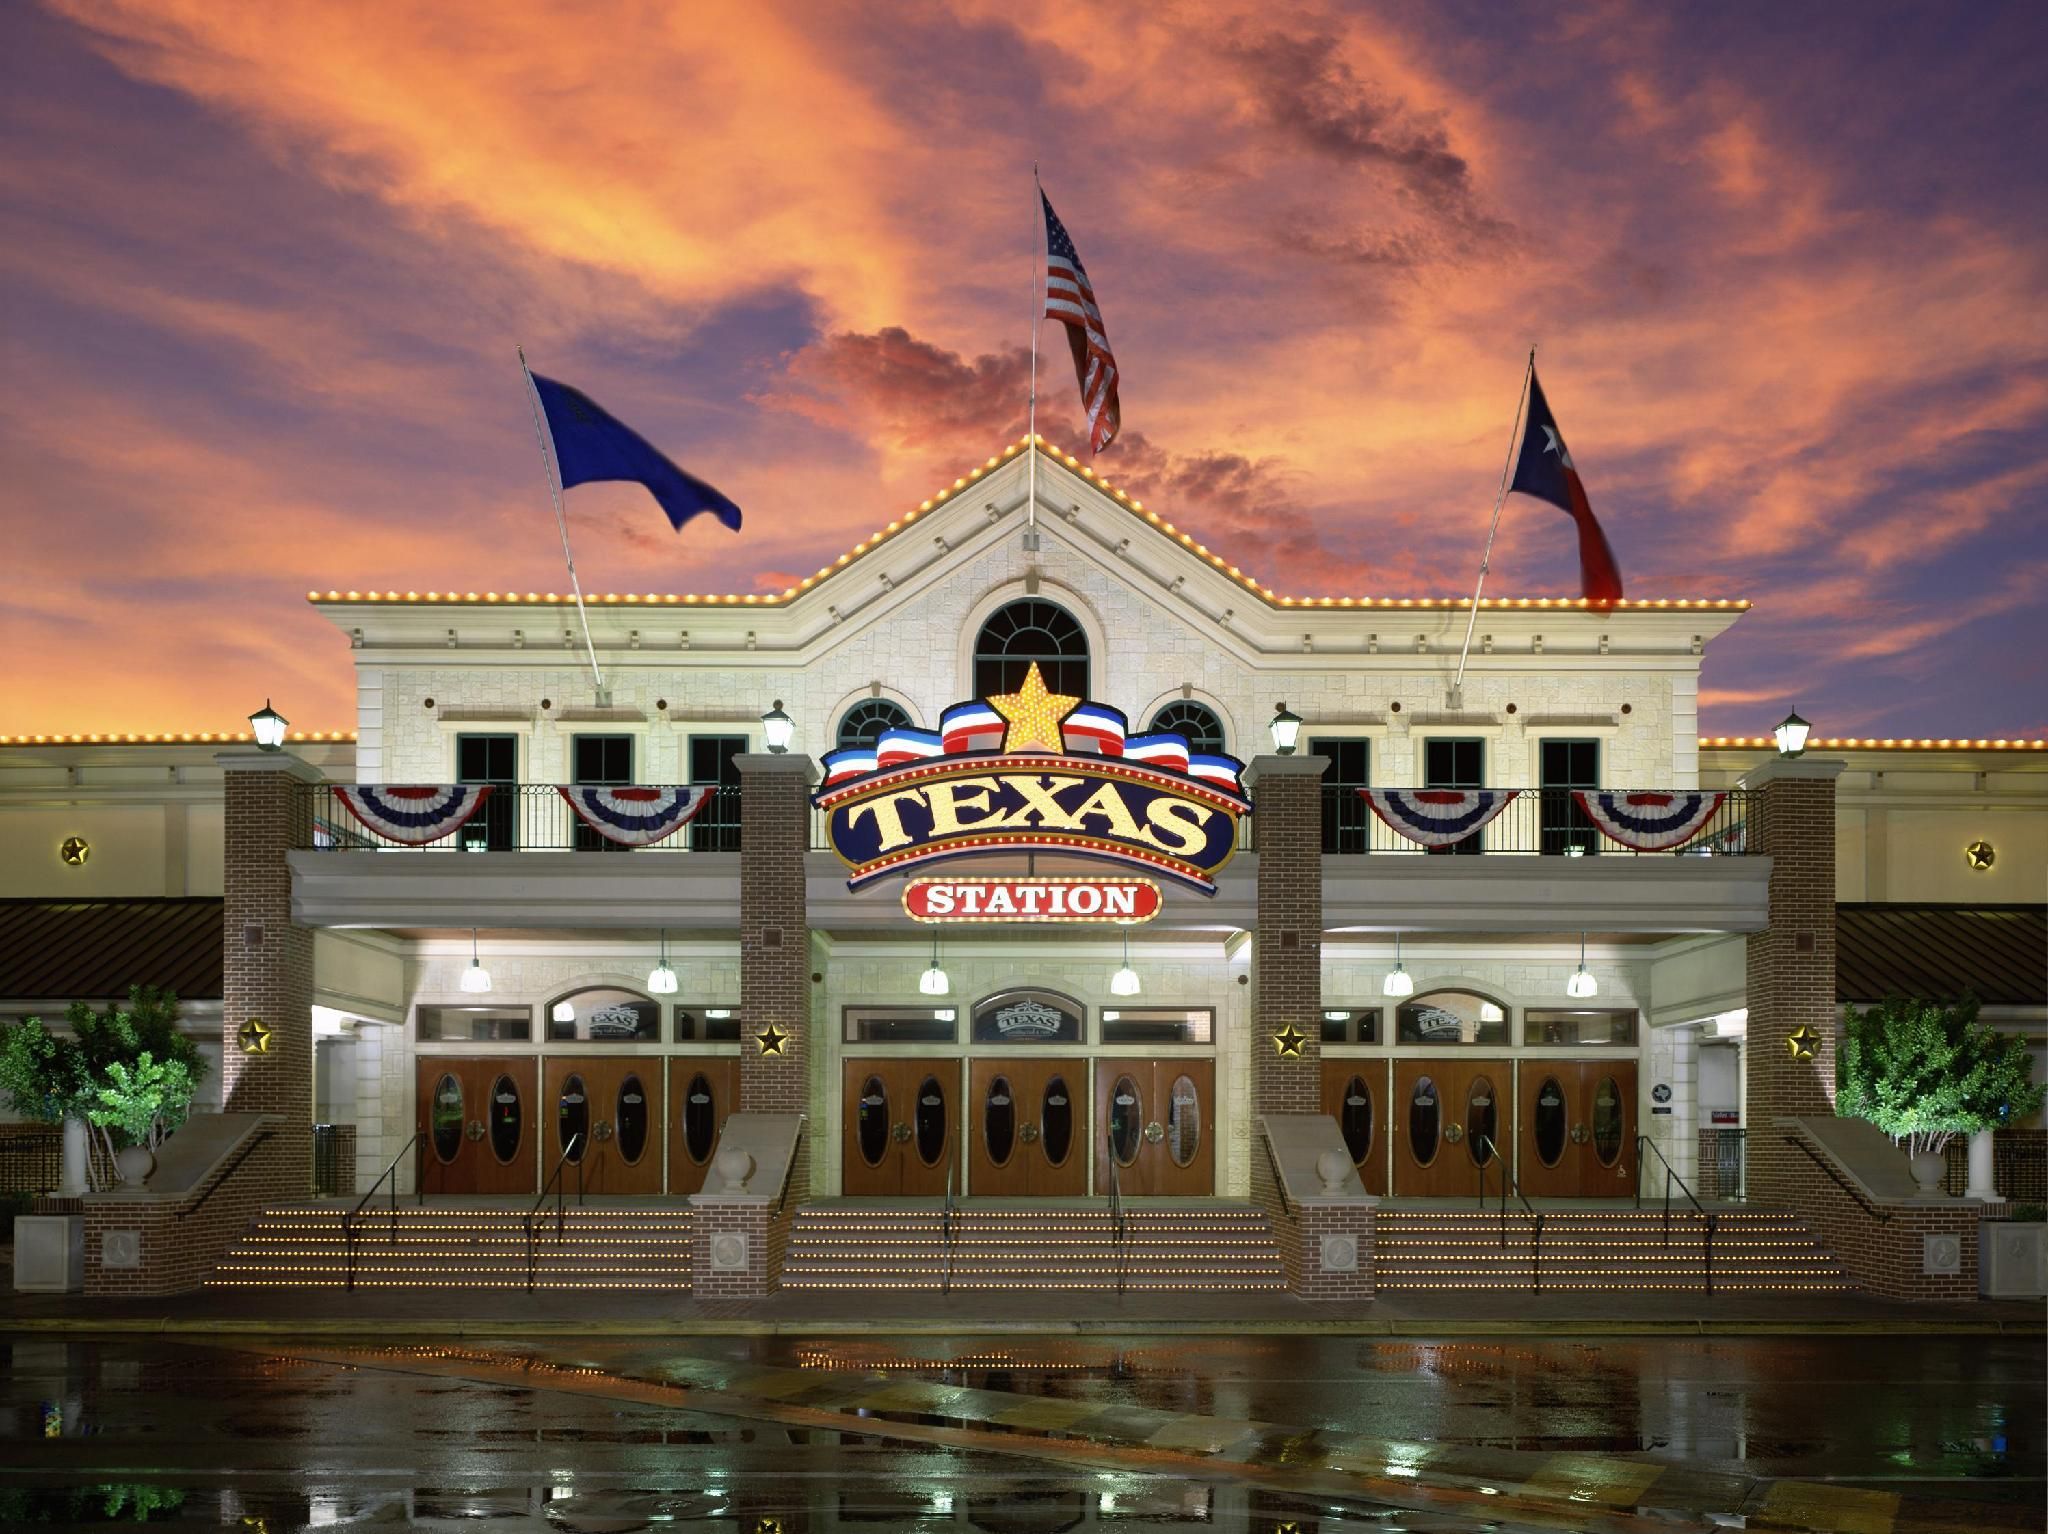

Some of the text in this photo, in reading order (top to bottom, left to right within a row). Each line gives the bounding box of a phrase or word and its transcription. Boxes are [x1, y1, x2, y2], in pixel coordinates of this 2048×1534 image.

[848, 776, 1213, 856] TEXAS
[926, 886, 1138, 914] STATION
[590, 1013, 631, 1026] EXAS
[1002, 1014, 1055, 1026] TEXAS
